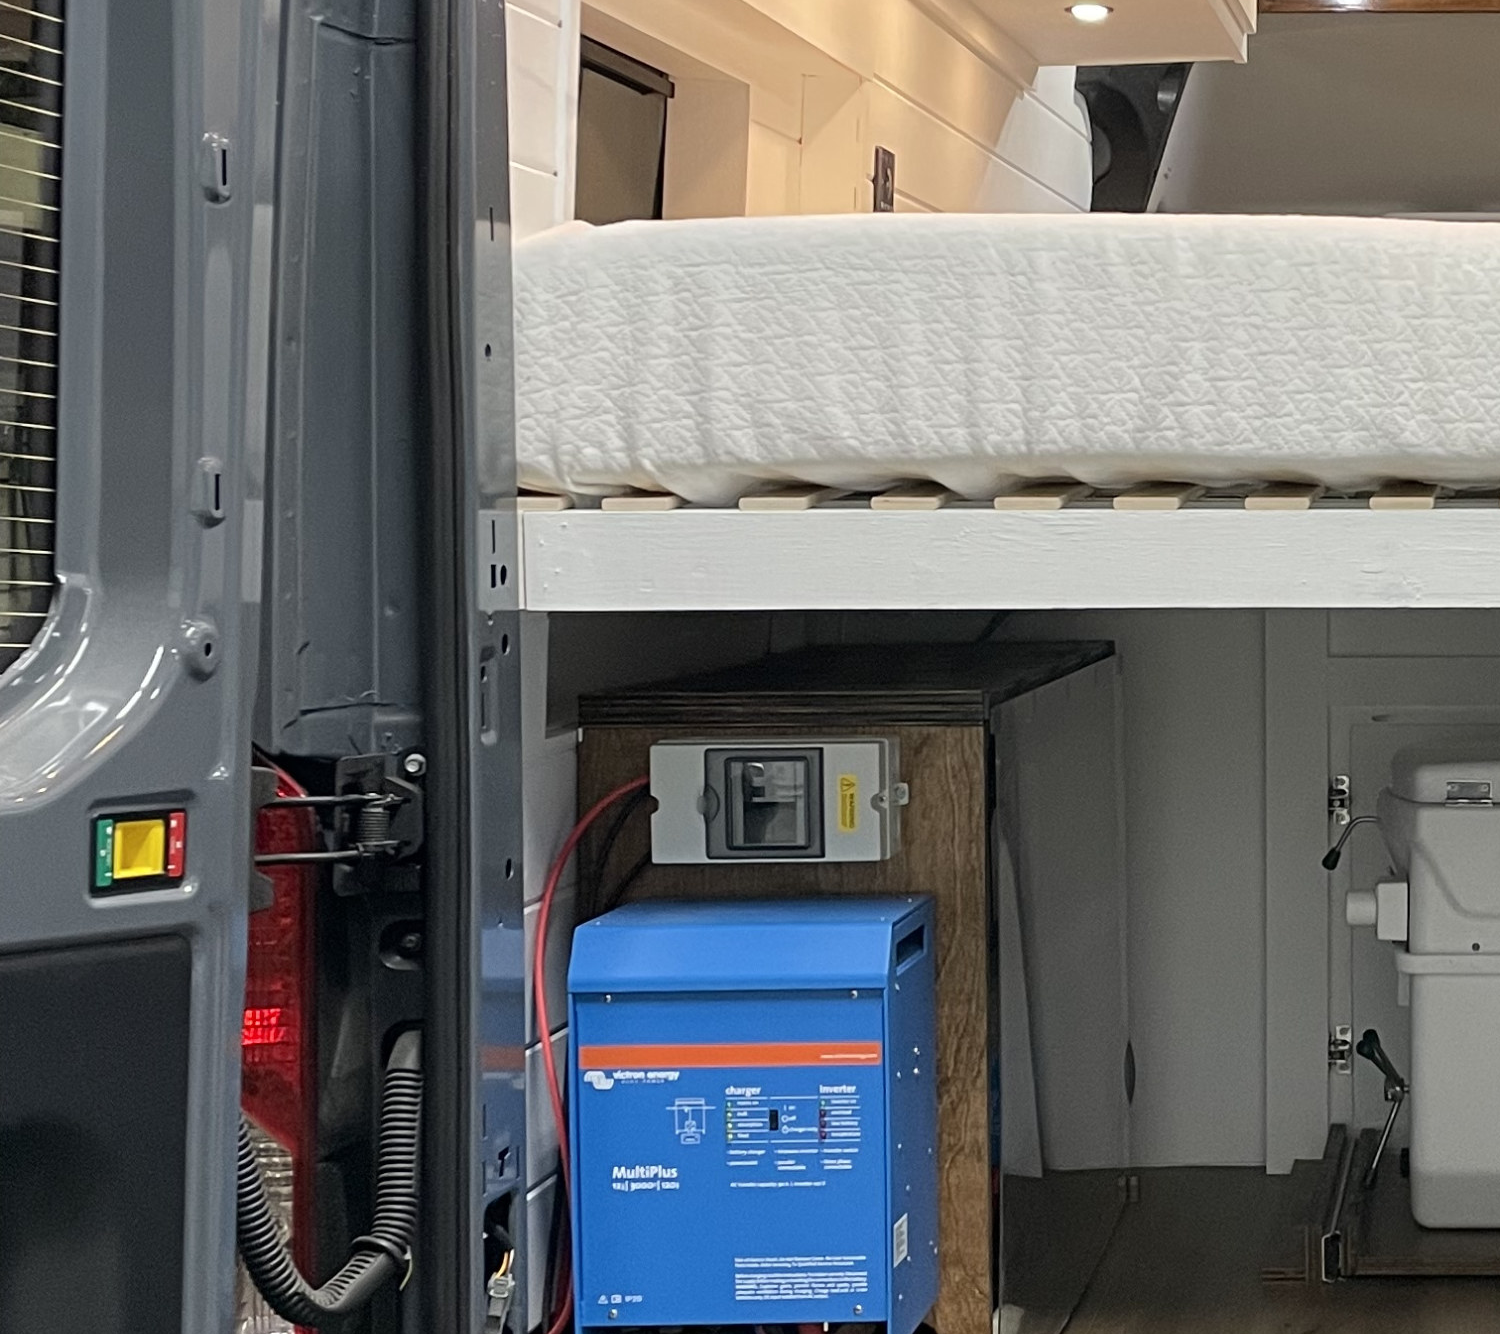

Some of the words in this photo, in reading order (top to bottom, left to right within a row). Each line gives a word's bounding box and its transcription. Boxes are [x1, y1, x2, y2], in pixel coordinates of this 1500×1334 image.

[646, 1071, 680, 1082] energy
[725, 1085, 762, 1098] charger
[612, 1165, 678, 1179] MultiPlus
